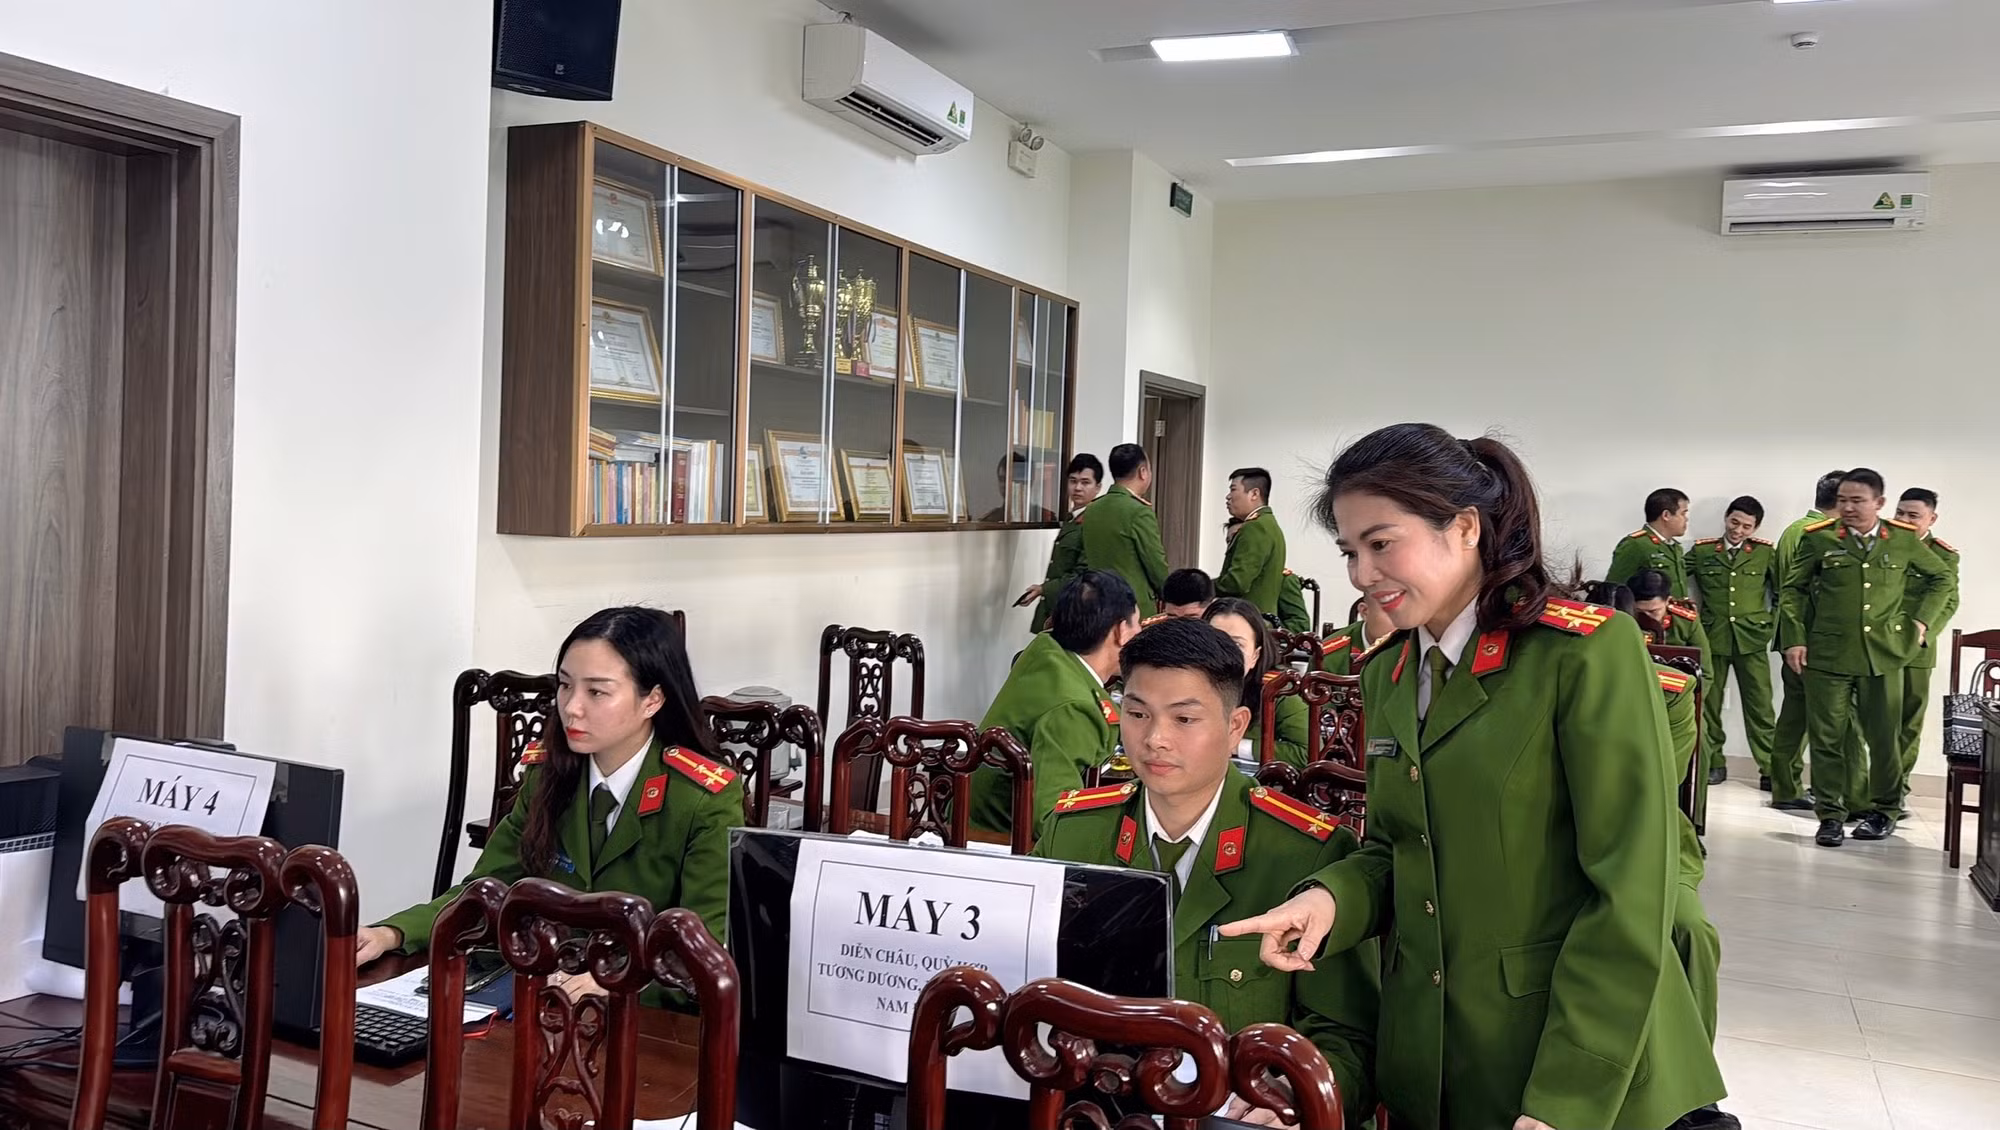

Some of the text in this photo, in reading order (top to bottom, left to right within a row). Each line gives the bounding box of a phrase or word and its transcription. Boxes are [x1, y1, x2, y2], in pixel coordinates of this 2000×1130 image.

[136, 775, 221, 815] MÁY 4
[854, 886, 981, 941] MÁY 3
[875, 947, 919, 970] CHÂU,
[817, 963, 865, 982] TƯƠNG
[876, 997, 909, 1014] NAM
